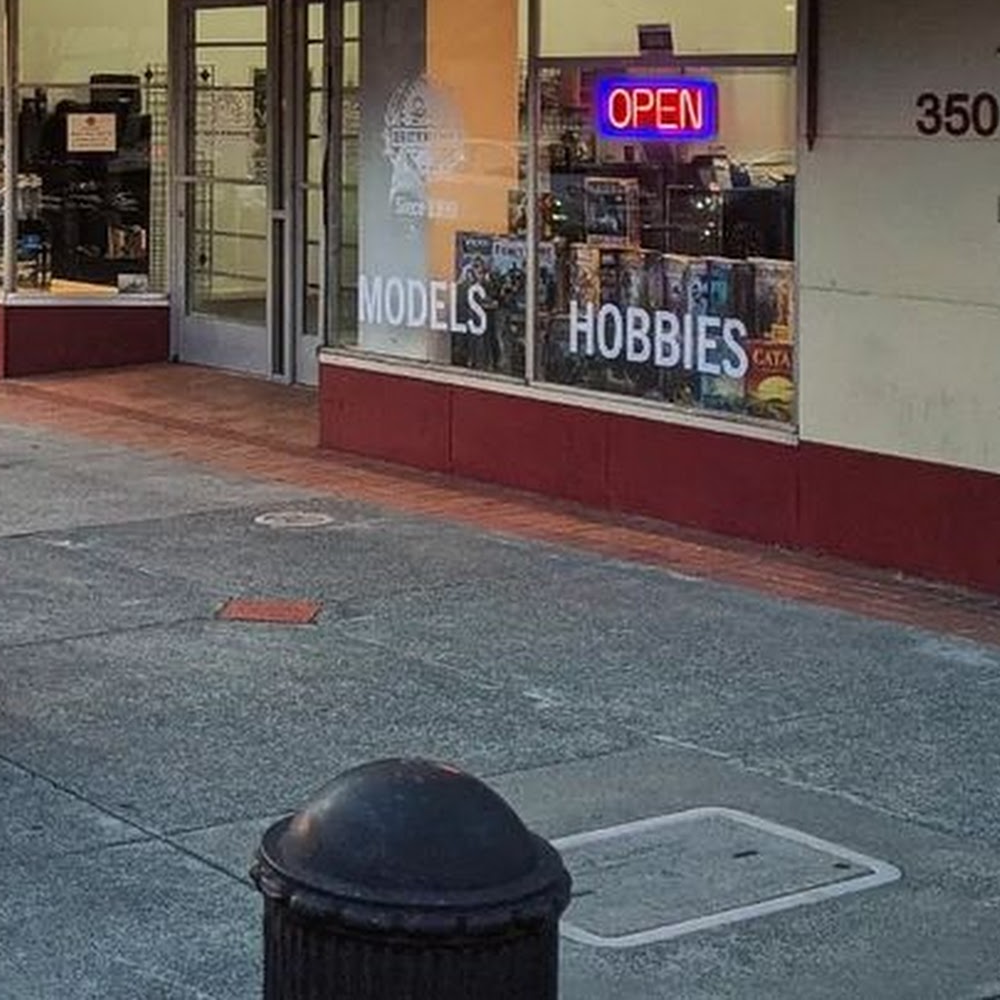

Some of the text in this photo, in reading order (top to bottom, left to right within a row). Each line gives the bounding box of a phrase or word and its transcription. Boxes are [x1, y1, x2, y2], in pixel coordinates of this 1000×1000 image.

[608, 88, 704, 130] OPEN
[915, 92, 999, 136] 350
[358, 274, 488, 336] MODELS
[568, 299, 749, 379] HOBBIES
